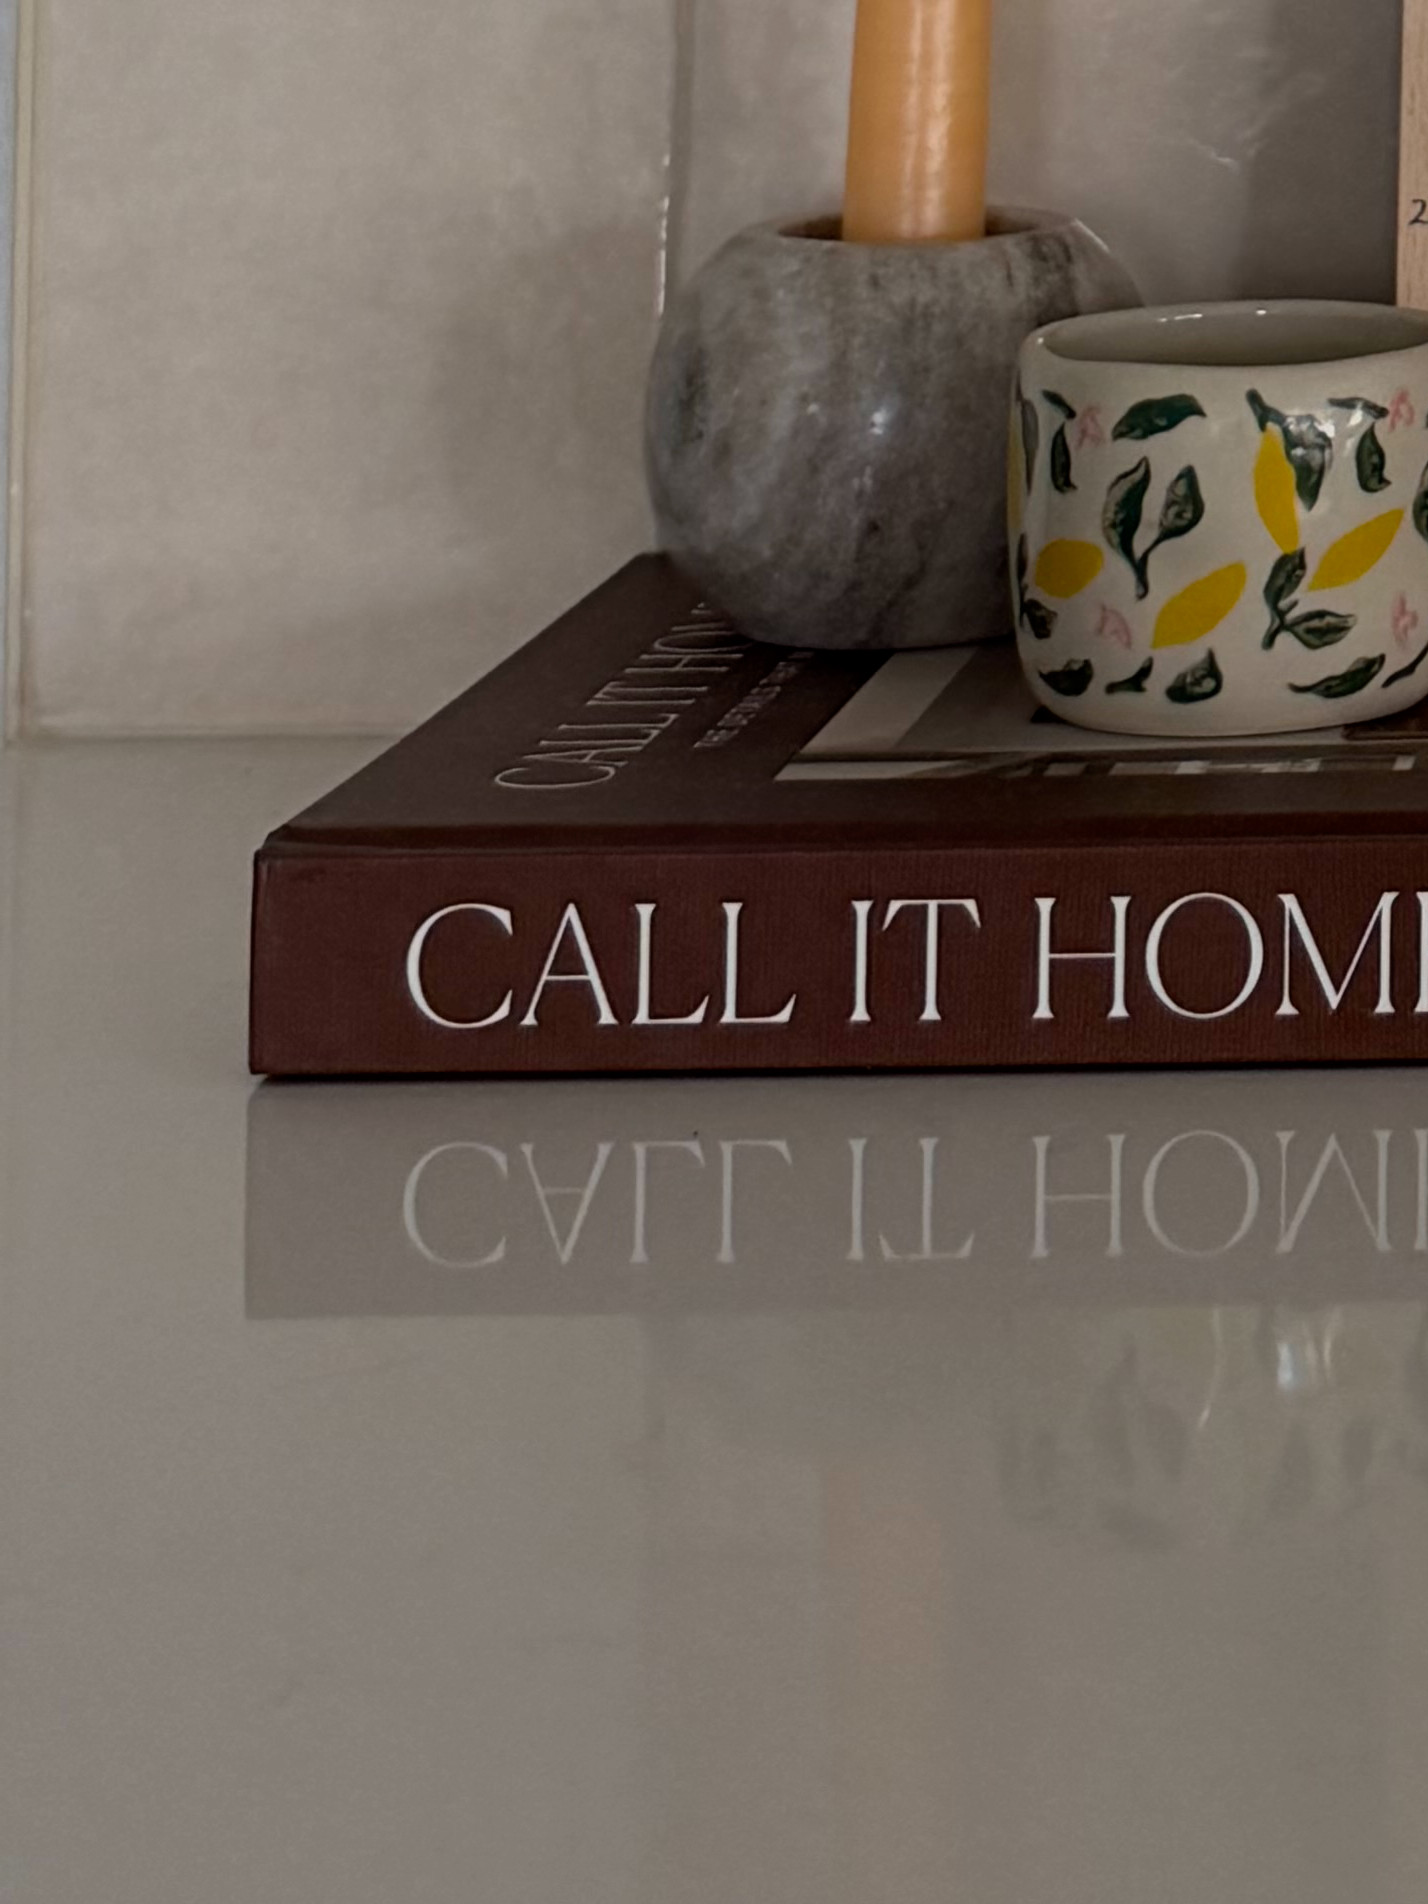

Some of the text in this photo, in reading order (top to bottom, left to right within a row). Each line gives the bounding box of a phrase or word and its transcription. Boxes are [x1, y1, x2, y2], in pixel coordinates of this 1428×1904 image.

[624, 602, 756, 675] HO
[585, 681, 709, 707] IT
[494, 713, 680, 789] CALL
[405, 901, 796, 1030] CALL
[848, 897, 982, 1025] IT
